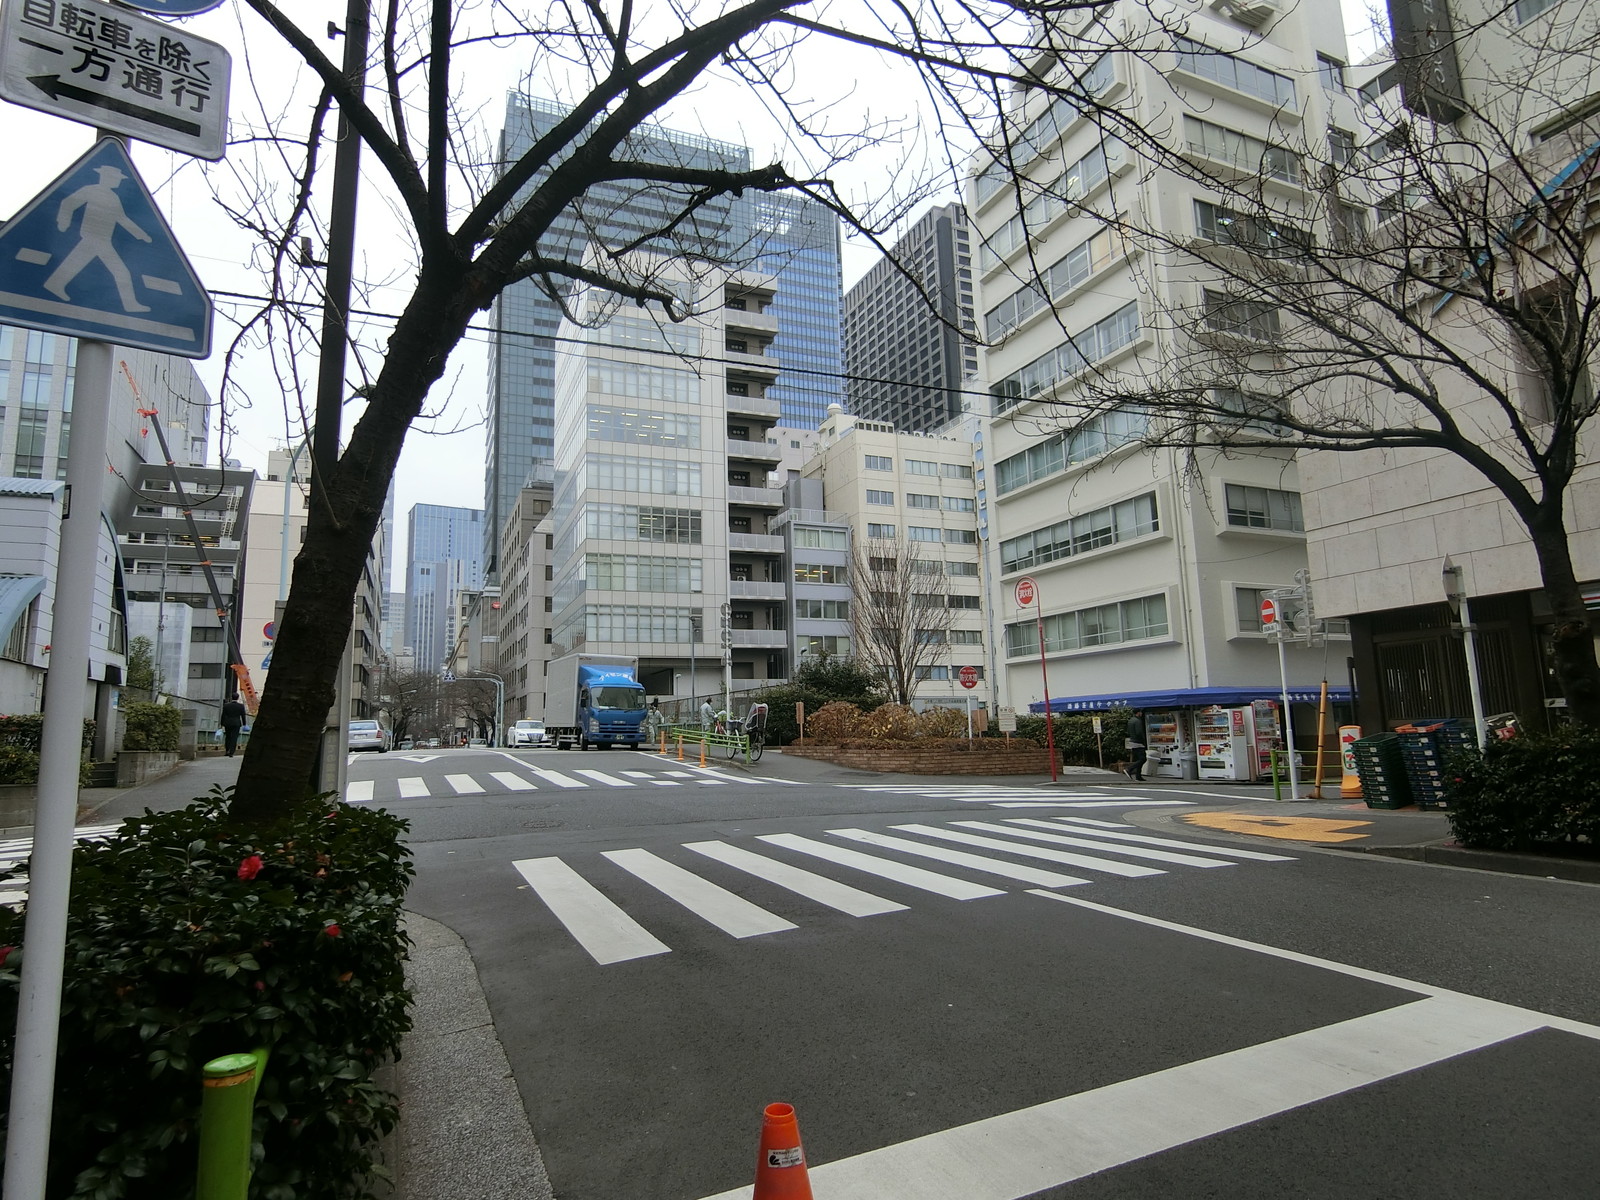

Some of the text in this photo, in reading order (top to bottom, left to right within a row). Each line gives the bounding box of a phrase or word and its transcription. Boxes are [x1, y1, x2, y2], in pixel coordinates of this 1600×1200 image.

[19, 37, 211, 113] 一方通行
[23, 0, 210, 81] 自転車を除く
